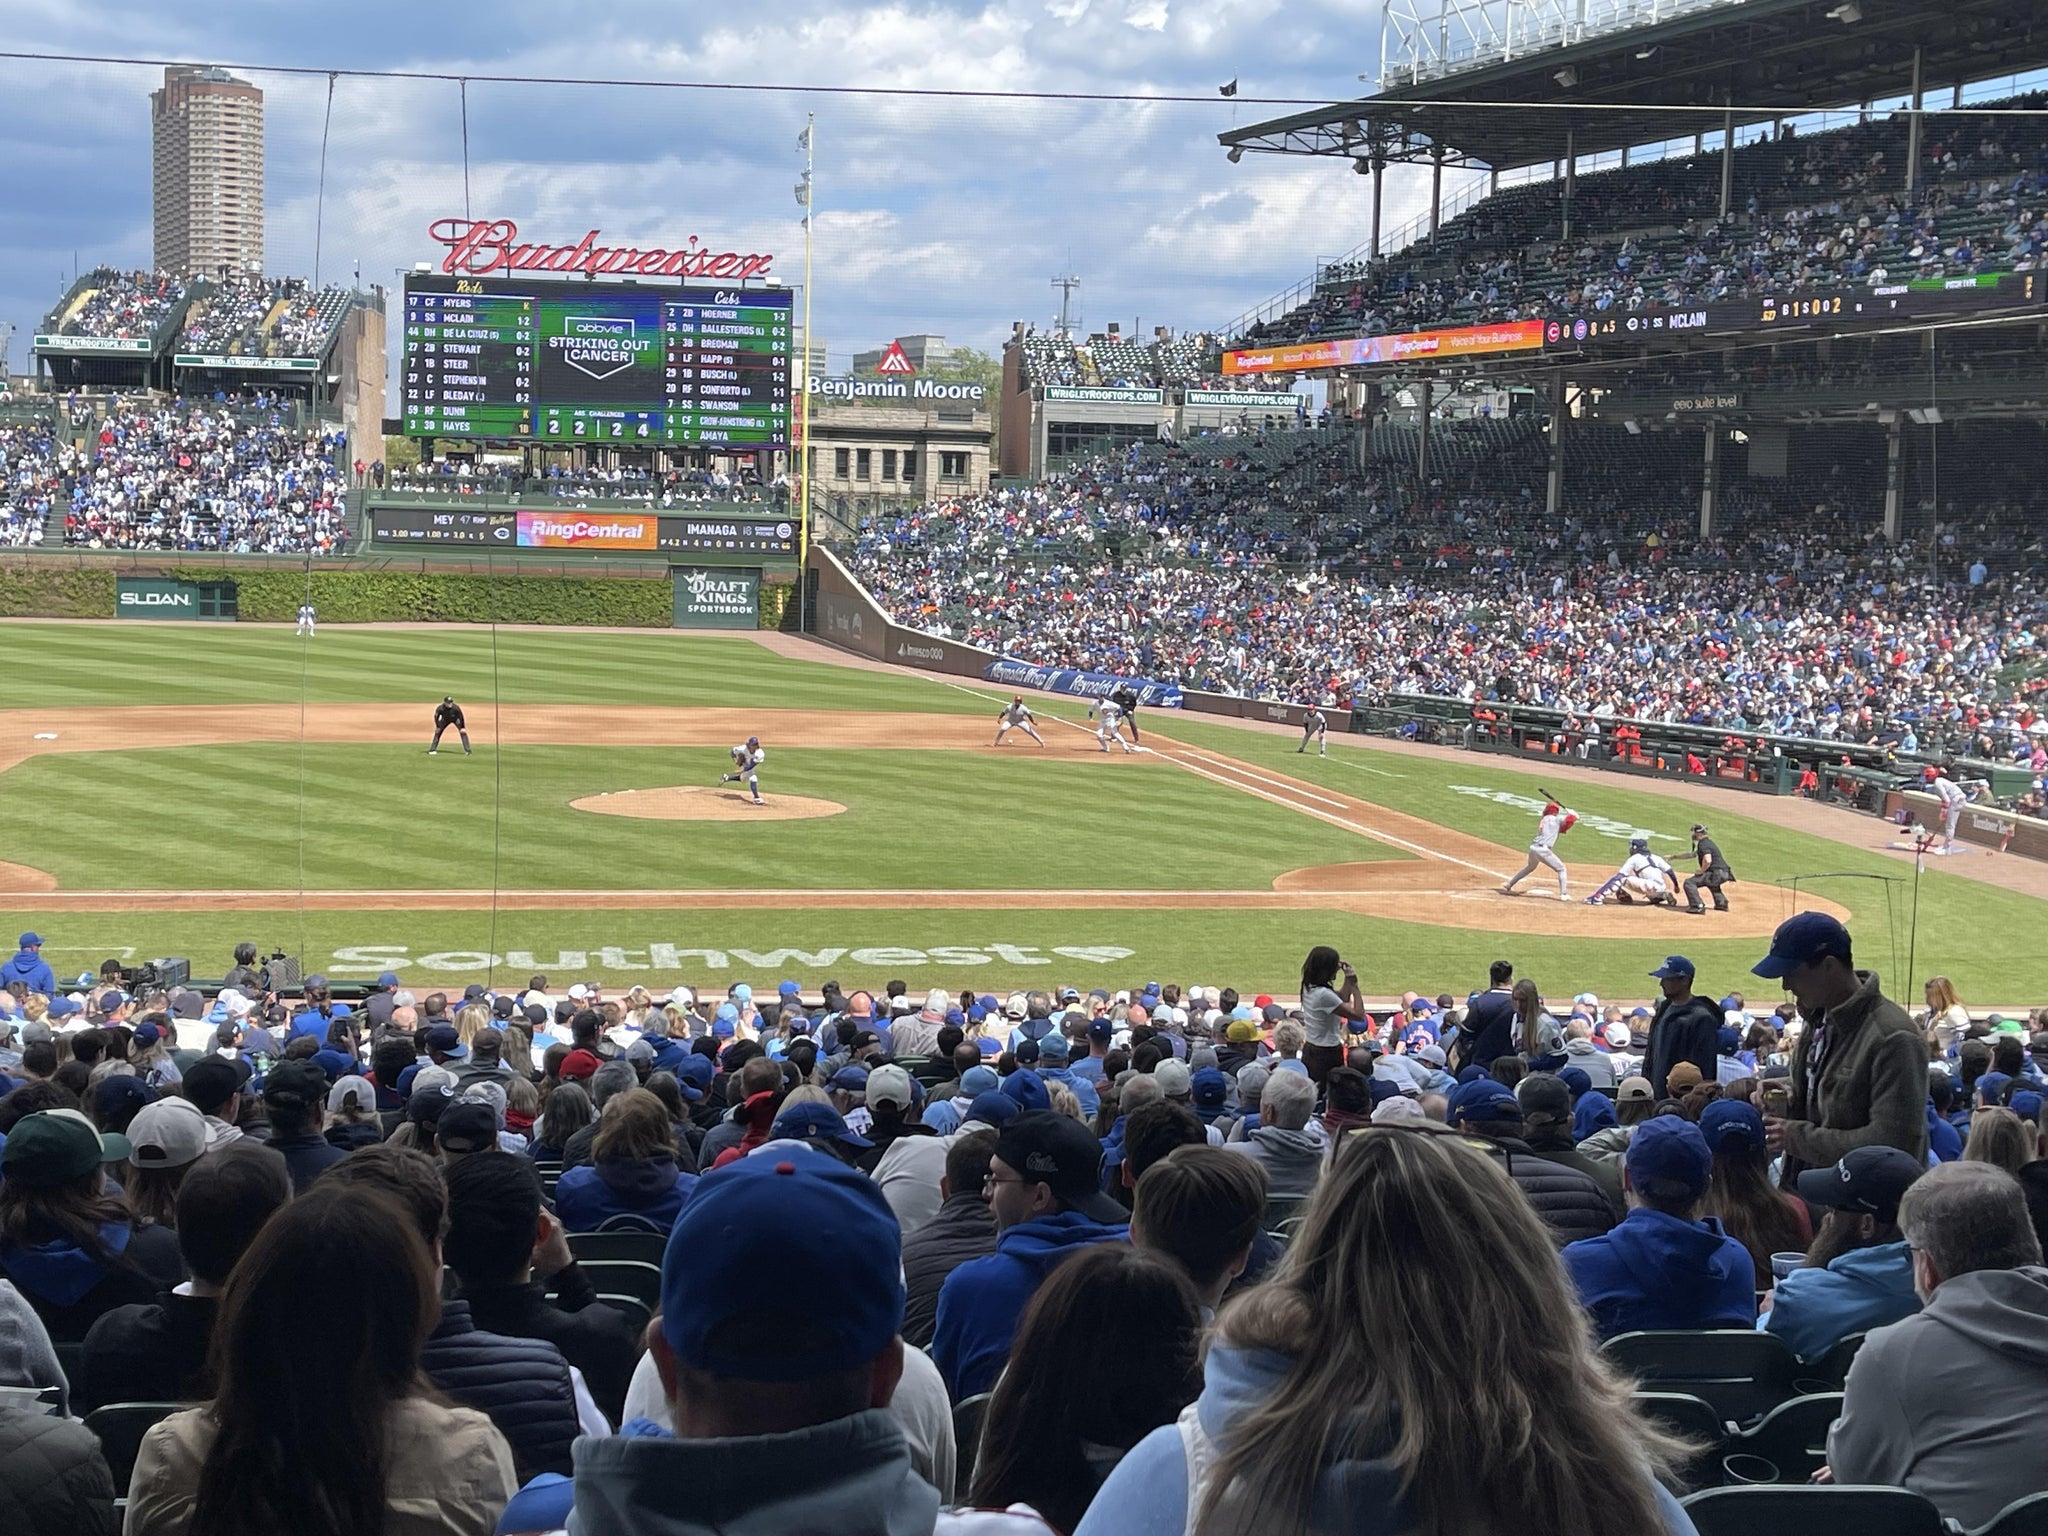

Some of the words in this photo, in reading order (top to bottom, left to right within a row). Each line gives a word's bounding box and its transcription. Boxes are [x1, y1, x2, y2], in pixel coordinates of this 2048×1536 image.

[428, 218, 773, 279] Budweiser
[456, 279, 484, 294] Reds
[409, 297, 418, 306] 17
[425, 298, 435, 306] CF
[443, 299, 471, 308] MYERS
[714, 291, 740, 305] Cubs
[1793, 302, 1799, 316] 1
[1802, 302, 1809, 313] S
[1812, 299, 1820, 314] 0
[1833, 297, 1840, 313] 2
[410, 312, 416, 321] 9
[425, 313, 435, 322] SS
[443, 314, 474, 323] MCLAIN
[669, 309, 674, 317] 2
[701, 309, 737, 320] HOERNER
[1653, 318, 1663, 327] SS
[1669, 312, 1707, 328] MCLAIN
[408, 328, 419, 336] 44
[443, 327, 457, 338] DE
[455, 328, 466, 338] LA
[576, 324, 623, 334] abbvie
[666, 323, 677, 332] 25
[682, 324, 694, 333] DH
[701, 324, 754, 335] BALLESTEROS
[1590, 322, 1597, 336] 8
[1609, 320, 1615, 332] 5
[49, 338, 138, 349] WRIGLEYROOFTOPS.COM
[549, 337, 618, 349] STRIKING
[622, 340, 650, 351] OUT
[669, 338, 674, 347] 3
[683, 338, 693, 347] 3B
[701, 339, 738, 350] BREGMAN
[1393, 337, 1439, 353] RingCentral
[1492, 331, 1522, 343] Business
[408, 343, 418, 351] 27
[424, 343, 435, 352] 2B
[443, 344, 481, 355] STEWART
[571, 349, 628, 361] CANCER
[203, 357, 292, 367] WRIGLEYROOFTOPS.COM
[410, 358, 416, 367] 7
[425, 359, 435, 367] 1B
[443, 359, 468, 369] STEER
[668, 353, 674, 362] 8
[683, 354, 692, 362] LF
[701, 355, 723, 364] HAPP
[408, 374, 418, 383] 37
[427, 375, 433, 383] C
[666, 368, 676, 377] 29
[683, 369, 692, 378] 1B
[701, 370, 727, 380] BUSCH
[666, 384, 676, 393] 20
[682, 385, 692, 393] RF
[700, 385, 740, 396] CONFORTO
[808, 377, 906, 400] Benjamin
[914, 379, 983, 399] Moore
[408, 390, 418, 398] 22
[425, 390, 435, 399] LF
[443, 391, 474, 401] BLEDAY
[1050, 388, 1157, 402] WRIGLEYROOFTOPS.COM
[1190, 393, 1298, 405] WRIGLEYROOFTOPS.COM
[668, 399, 673, 408] 7
[682, 400, 692, 409] SS
[700, 401, 739, 411] SWANSON
[1674, 400, 1692, 410] eero
[1695, 396, 1715, 408] suite
[1717, 395, 1737, 407] level
[408, 405, 418, 414] 59
[424, 406, 435, 415] RF
[443, 406, 465, 416] DUNN
[667, 415, 674, 424] 4
[682, 415, 692, 424] CF
[410, 421, 416, 429] 3
[424, 421, 435, 430] 3B
[443, 422, 470, 431] HAYES
[549, 420, 559, 434] 2
[574, 421, 584, 435] 2
[612, 423, 622, 436] 2
[638, 424, 648, 437] 4
[667, 430, 673, 439] 9
[684, 431, 690, 439] C
[700, 431, 728, 441] AMAYA
[434, 515, 454, 524] MEY
[460, 515, 471, 524] 47
[531, 519, 643, 539] RingCentral
[688, 524, 737, 535] IMANAGA
[687, 579, 750, 594] DRAFT
[120, 592, 189, 606] SLOAN
[695, 592, 748, 604] KINGS
[687, 604, 753, 614] SPORTSBOOK
[908, 644, 929, 658] Invesco
[990, 663, 1026, 682] Reynolds
[1069, 674, 1112, 695] Reynolds
[328, 943, 1052, 972] Southwest
